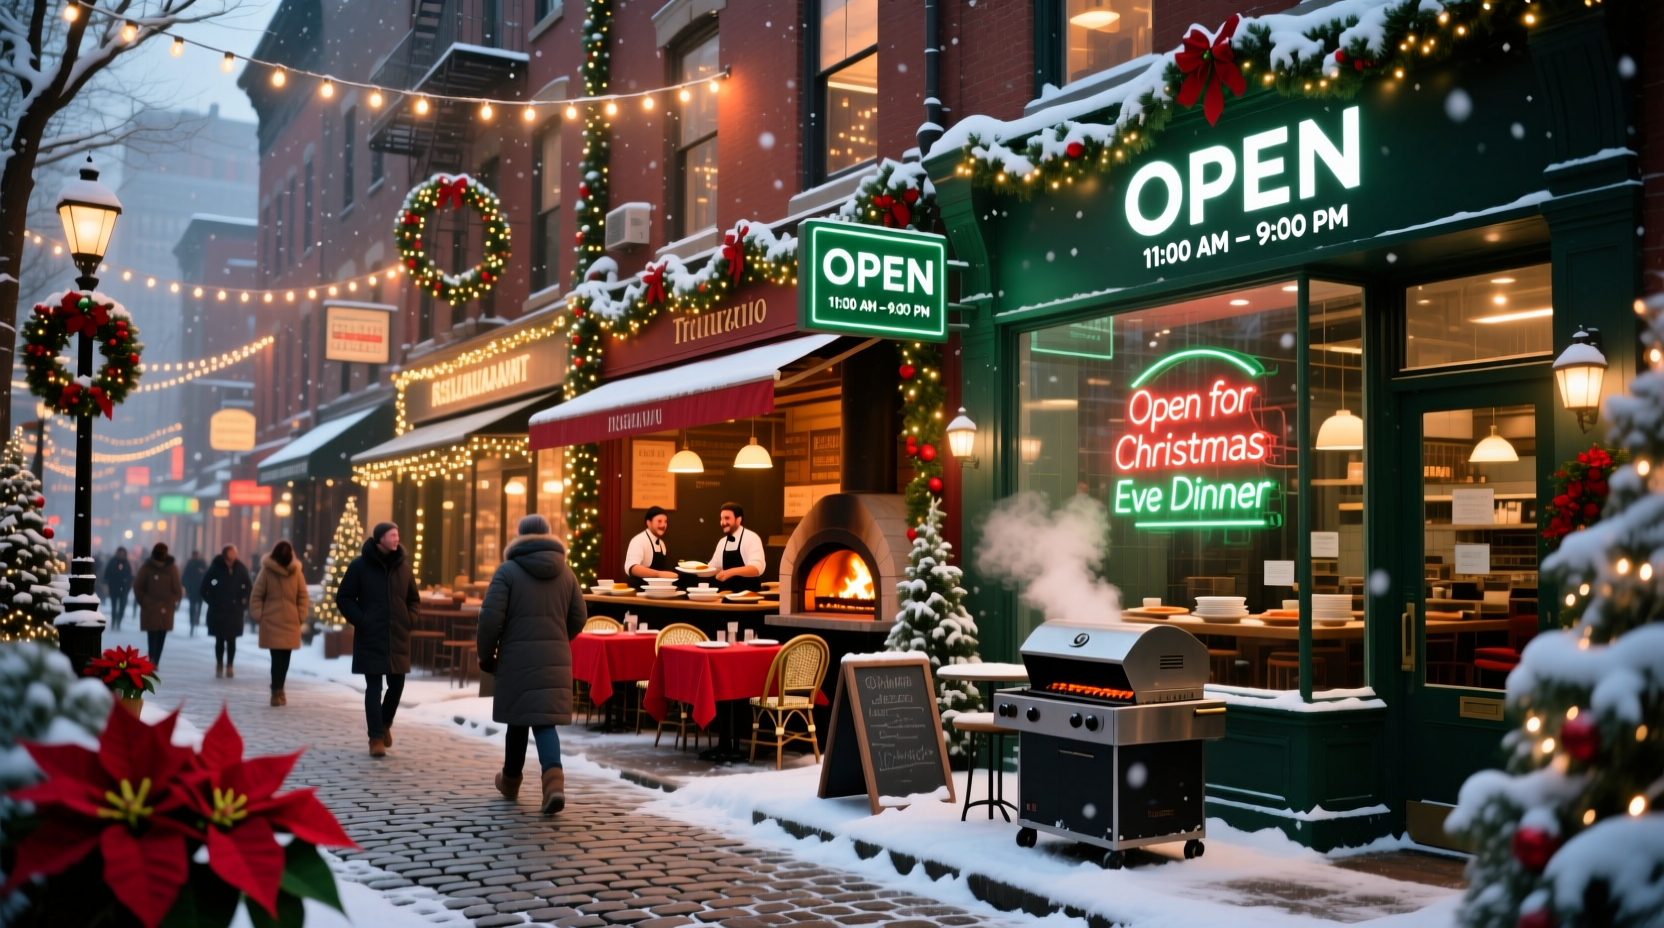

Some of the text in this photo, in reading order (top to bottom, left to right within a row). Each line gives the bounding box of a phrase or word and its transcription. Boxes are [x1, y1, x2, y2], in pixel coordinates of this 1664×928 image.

[1124, 105, 1361, 237] OPEN
[1143, 240, 1191, 269] 11:00
[1196, 230, 1229, 258] AM
[1256, 213, 1306, 246] 9:00
[1312, 203, 1349, 233] PM
[823, 248, 933, 295] OPEN
[859, 299, 877, 313] AM
[913, 304, 930, 318] PM
[1129, 380, 1254, 433] Open for
[1115, 432, 1264, 470] Christmas
[1115, 476, 1271, 513] Eve Dinner
